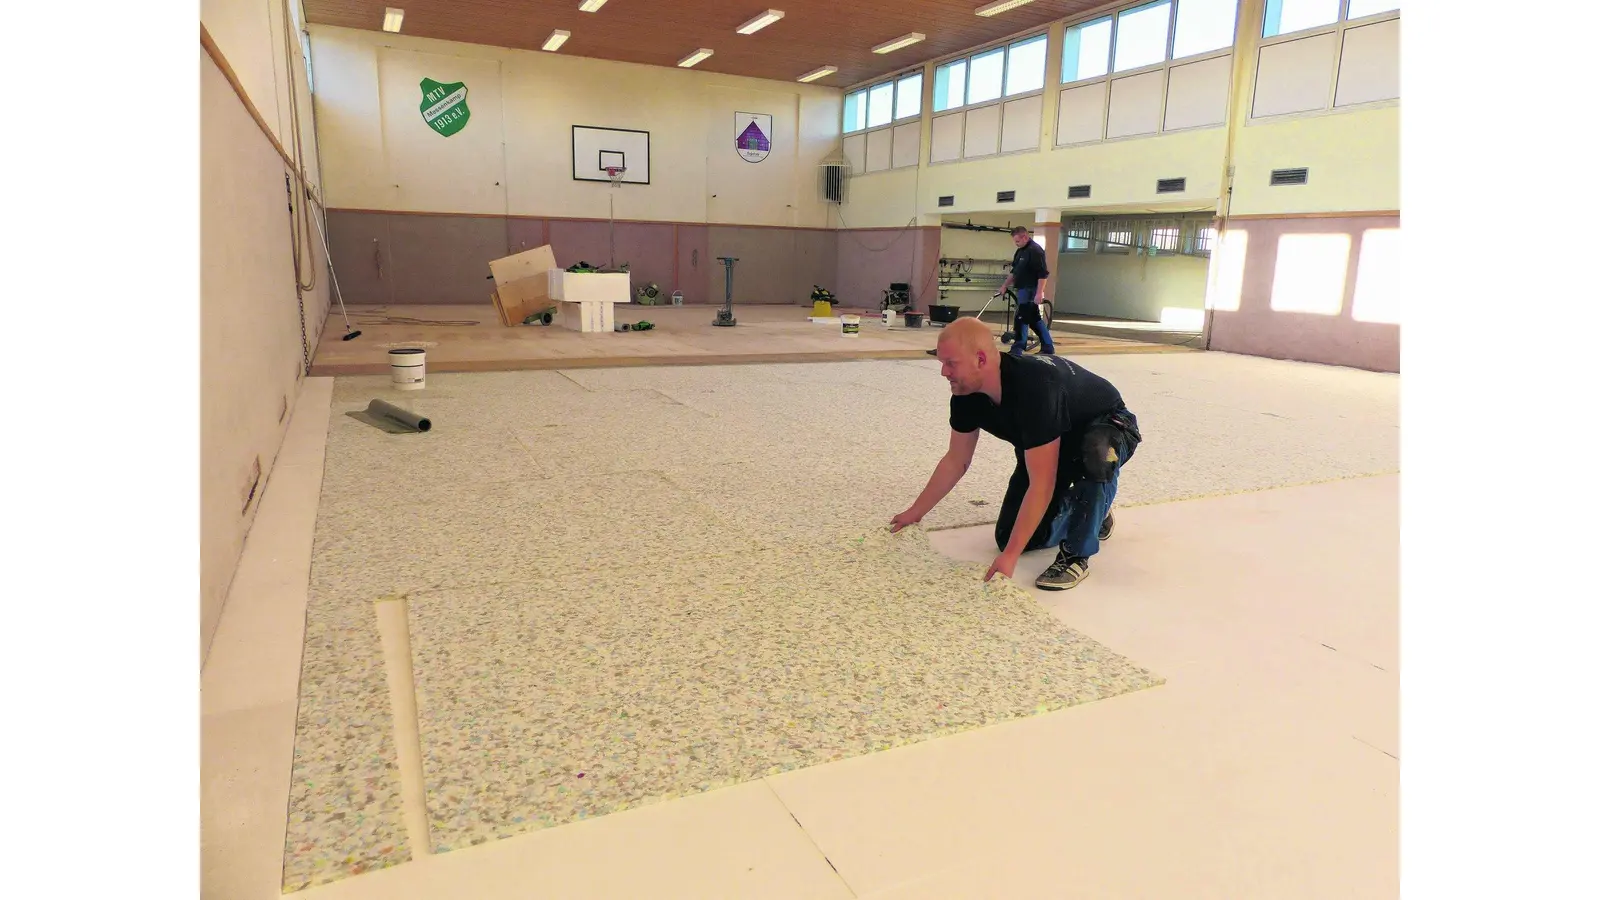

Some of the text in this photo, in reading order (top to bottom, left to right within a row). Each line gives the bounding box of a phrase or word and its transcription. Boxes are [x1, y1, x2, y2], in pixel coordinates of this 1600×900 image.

[426, 86, 445, 103] MTV
[427, 93, 462, 117] Messenkamp
[434, 107, 465, 130] 1913 e.V.
